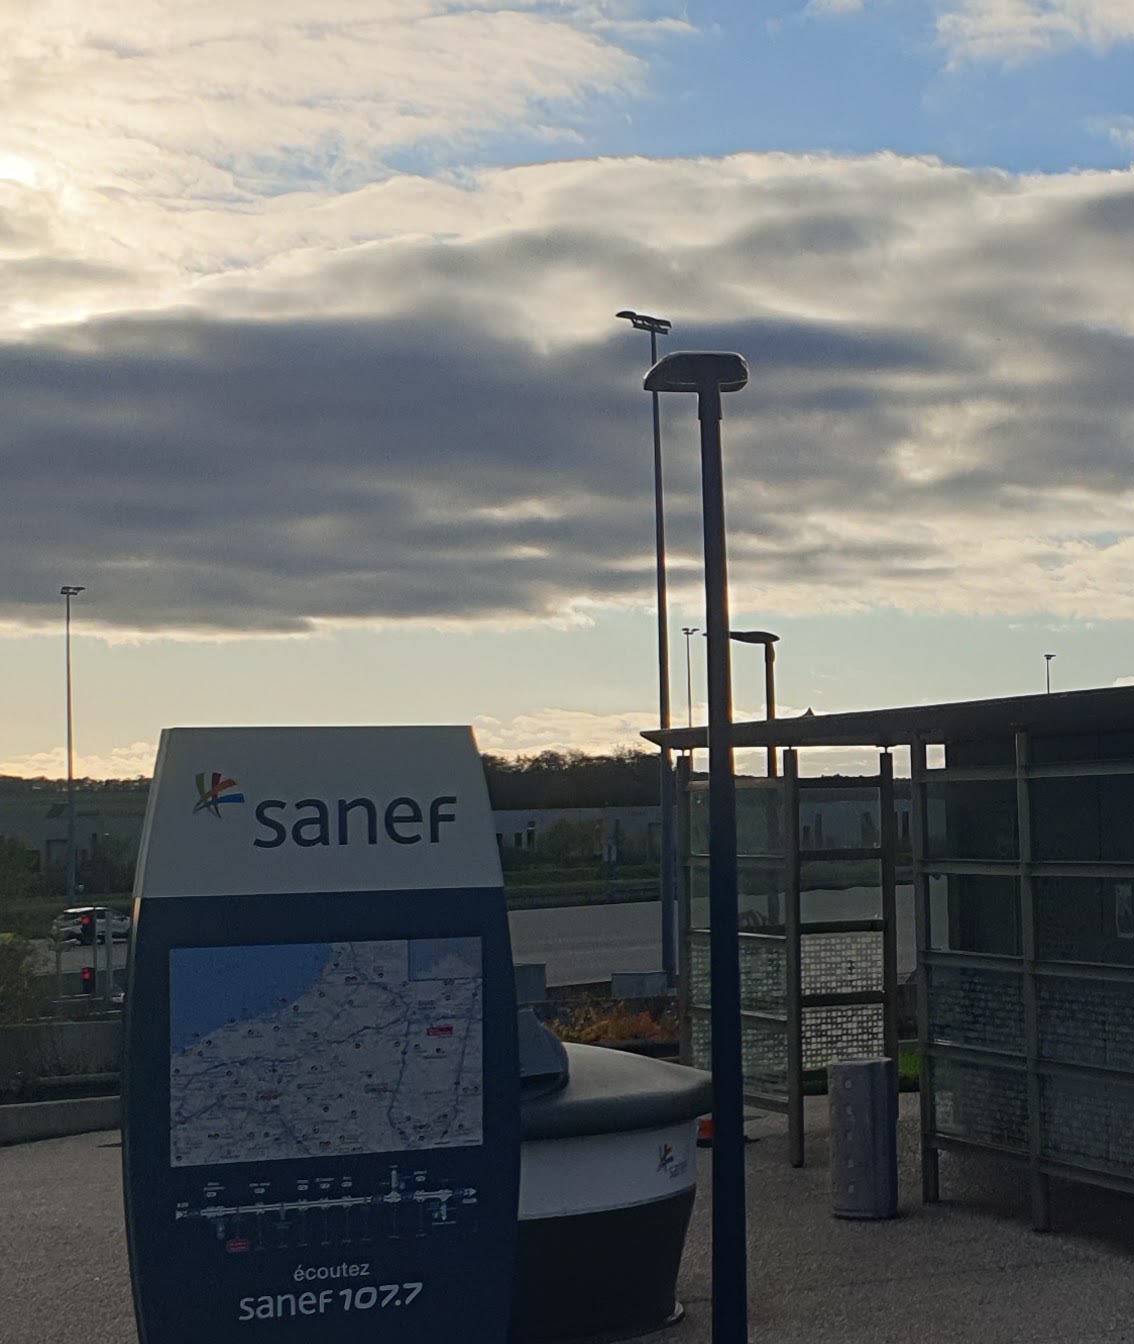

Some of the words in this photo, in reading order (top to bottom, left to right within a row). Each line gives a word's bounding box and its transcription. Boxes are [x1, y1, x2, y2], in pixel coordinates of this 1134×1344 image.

[252, 795, 458, 849] sanef
[293, 1263, 371, 1282] écoutez
[238, 1289, 334, 1321] sanef
[338, 1281, 424, 1312] 107.7
